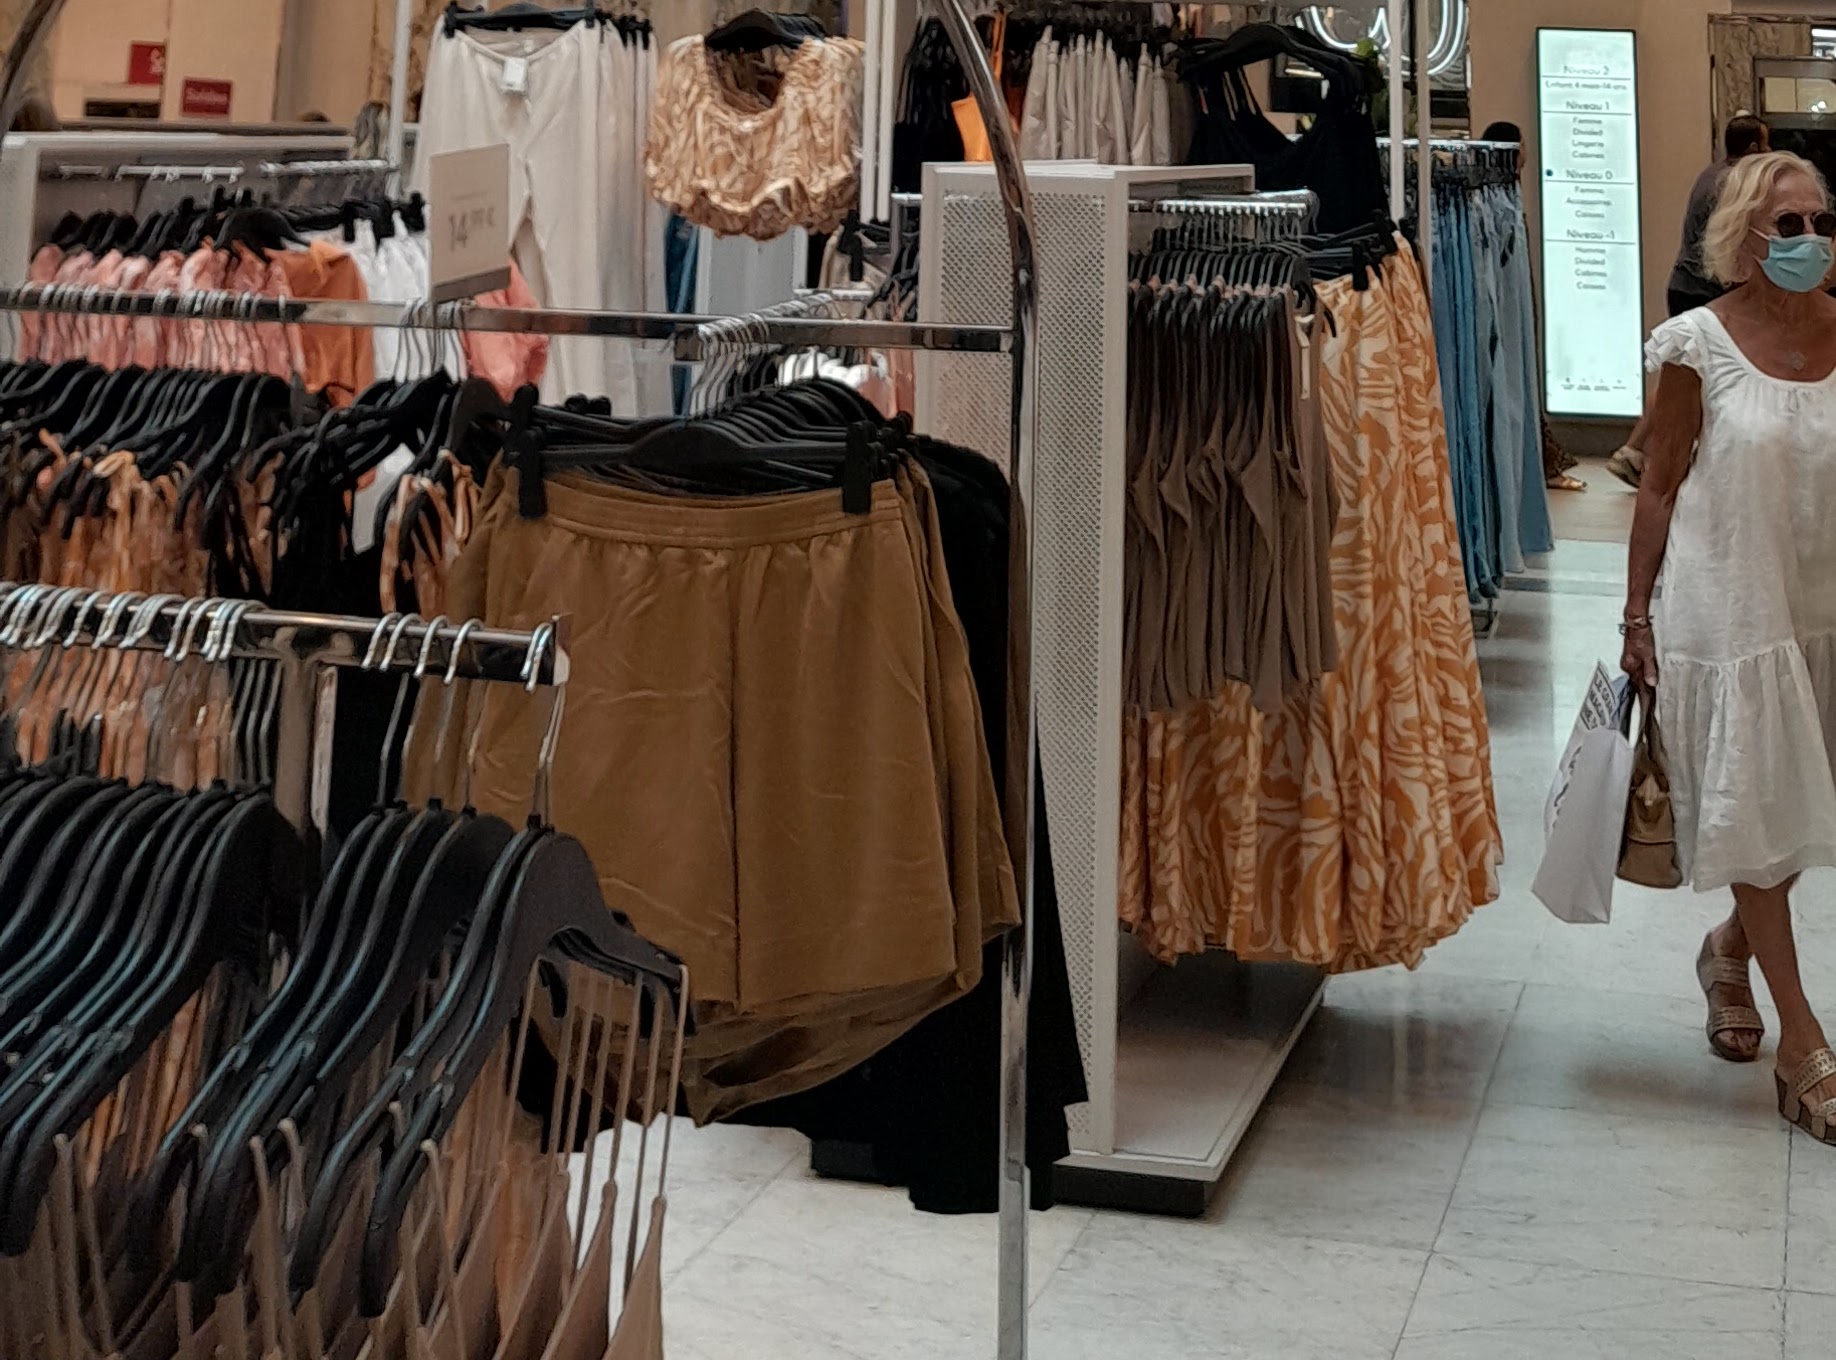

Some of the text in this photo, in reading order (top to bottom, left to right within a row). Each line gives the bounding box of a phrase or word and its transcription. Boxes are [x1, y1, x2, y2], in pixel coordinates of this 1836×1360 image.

[1603, 65, 1610, 76] 2
[1566, 101, 1603, 111] Niveau
[1566, 169, 1613, 180] Niveau 0
[1566, 228, 1603, 240] Niveau
